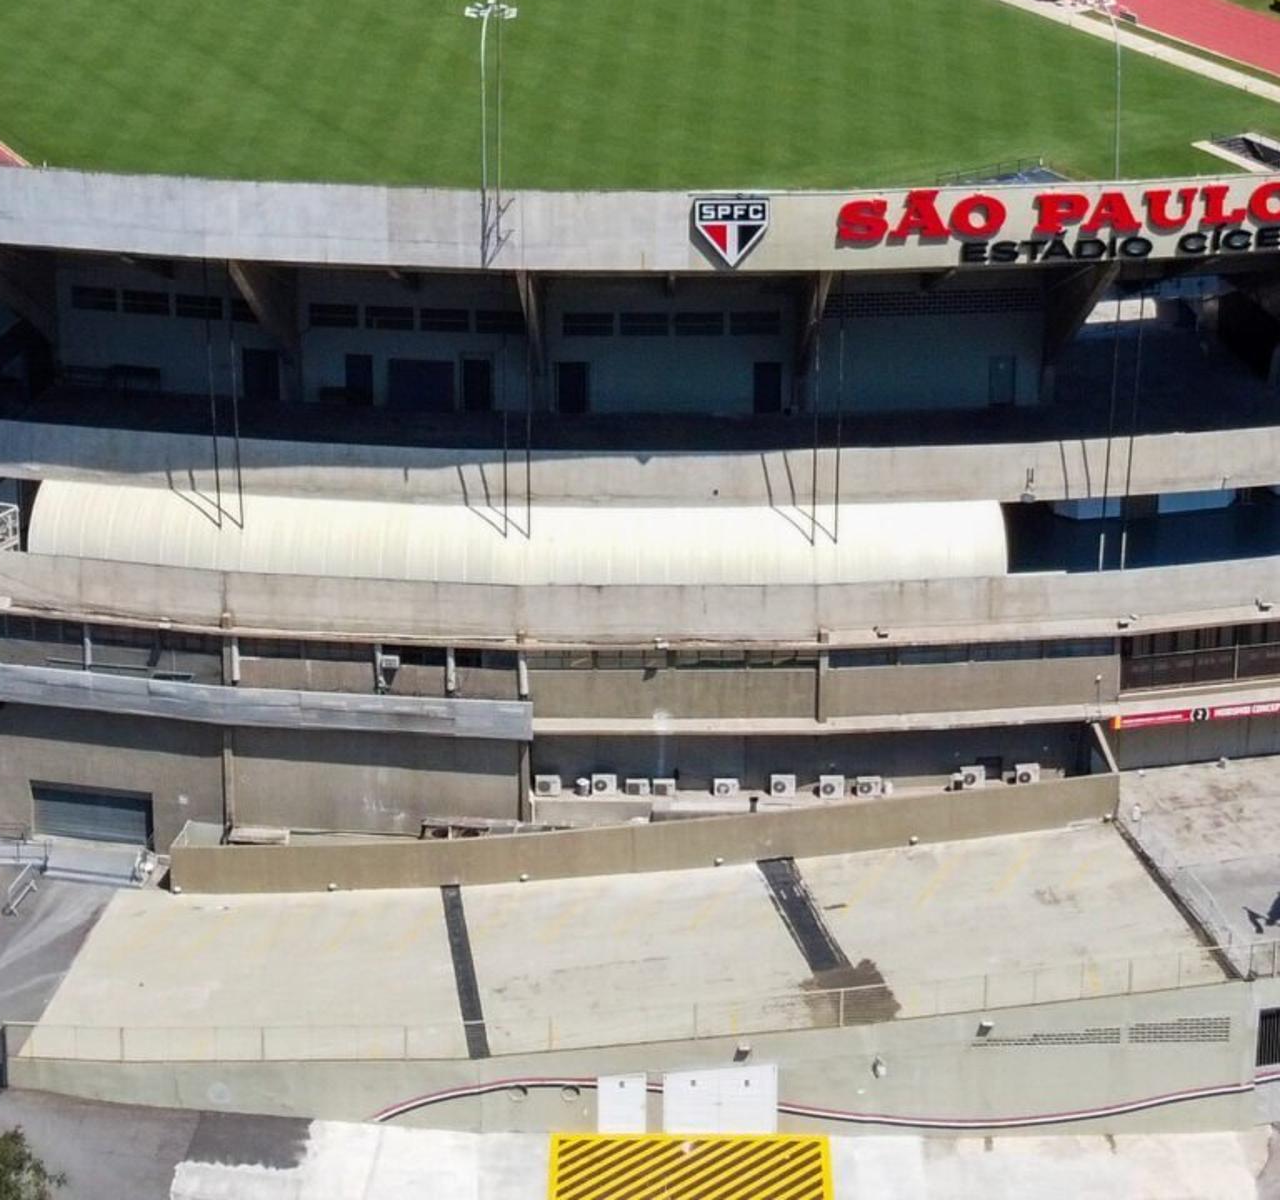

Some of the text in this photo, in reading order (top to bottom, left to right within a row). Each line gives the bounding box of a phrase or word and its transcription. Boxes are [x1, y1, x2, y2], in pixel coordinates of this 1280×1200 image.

[700, 204, 765, 221] SPFC
[836, 189, 1007, 245] SÃO
[962, 230, 1153, 263] ESTÁDIO
